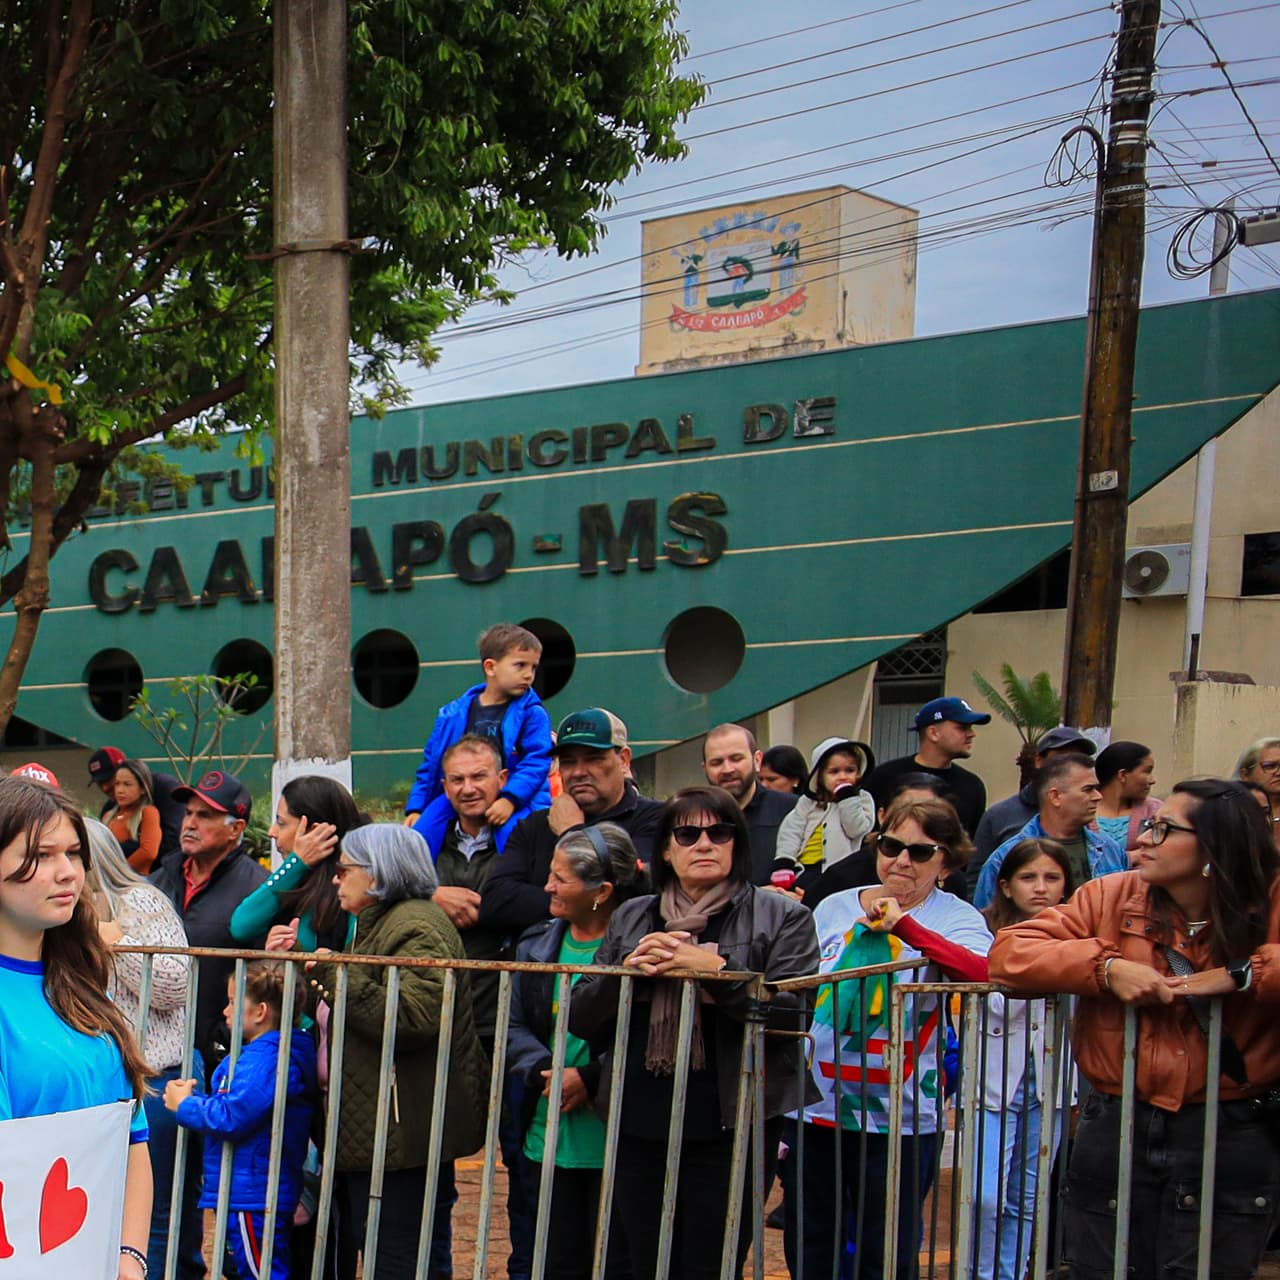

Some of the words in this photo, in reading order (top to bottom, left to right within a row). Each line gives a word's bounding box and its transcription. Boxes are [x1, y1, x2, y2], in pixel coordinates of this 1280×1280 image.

[372, 413, 716, 486] MUNICIPAL
[743, 396, 837, 444] DE
[88, 491, 728, 614] CAAAPÓ-MS
